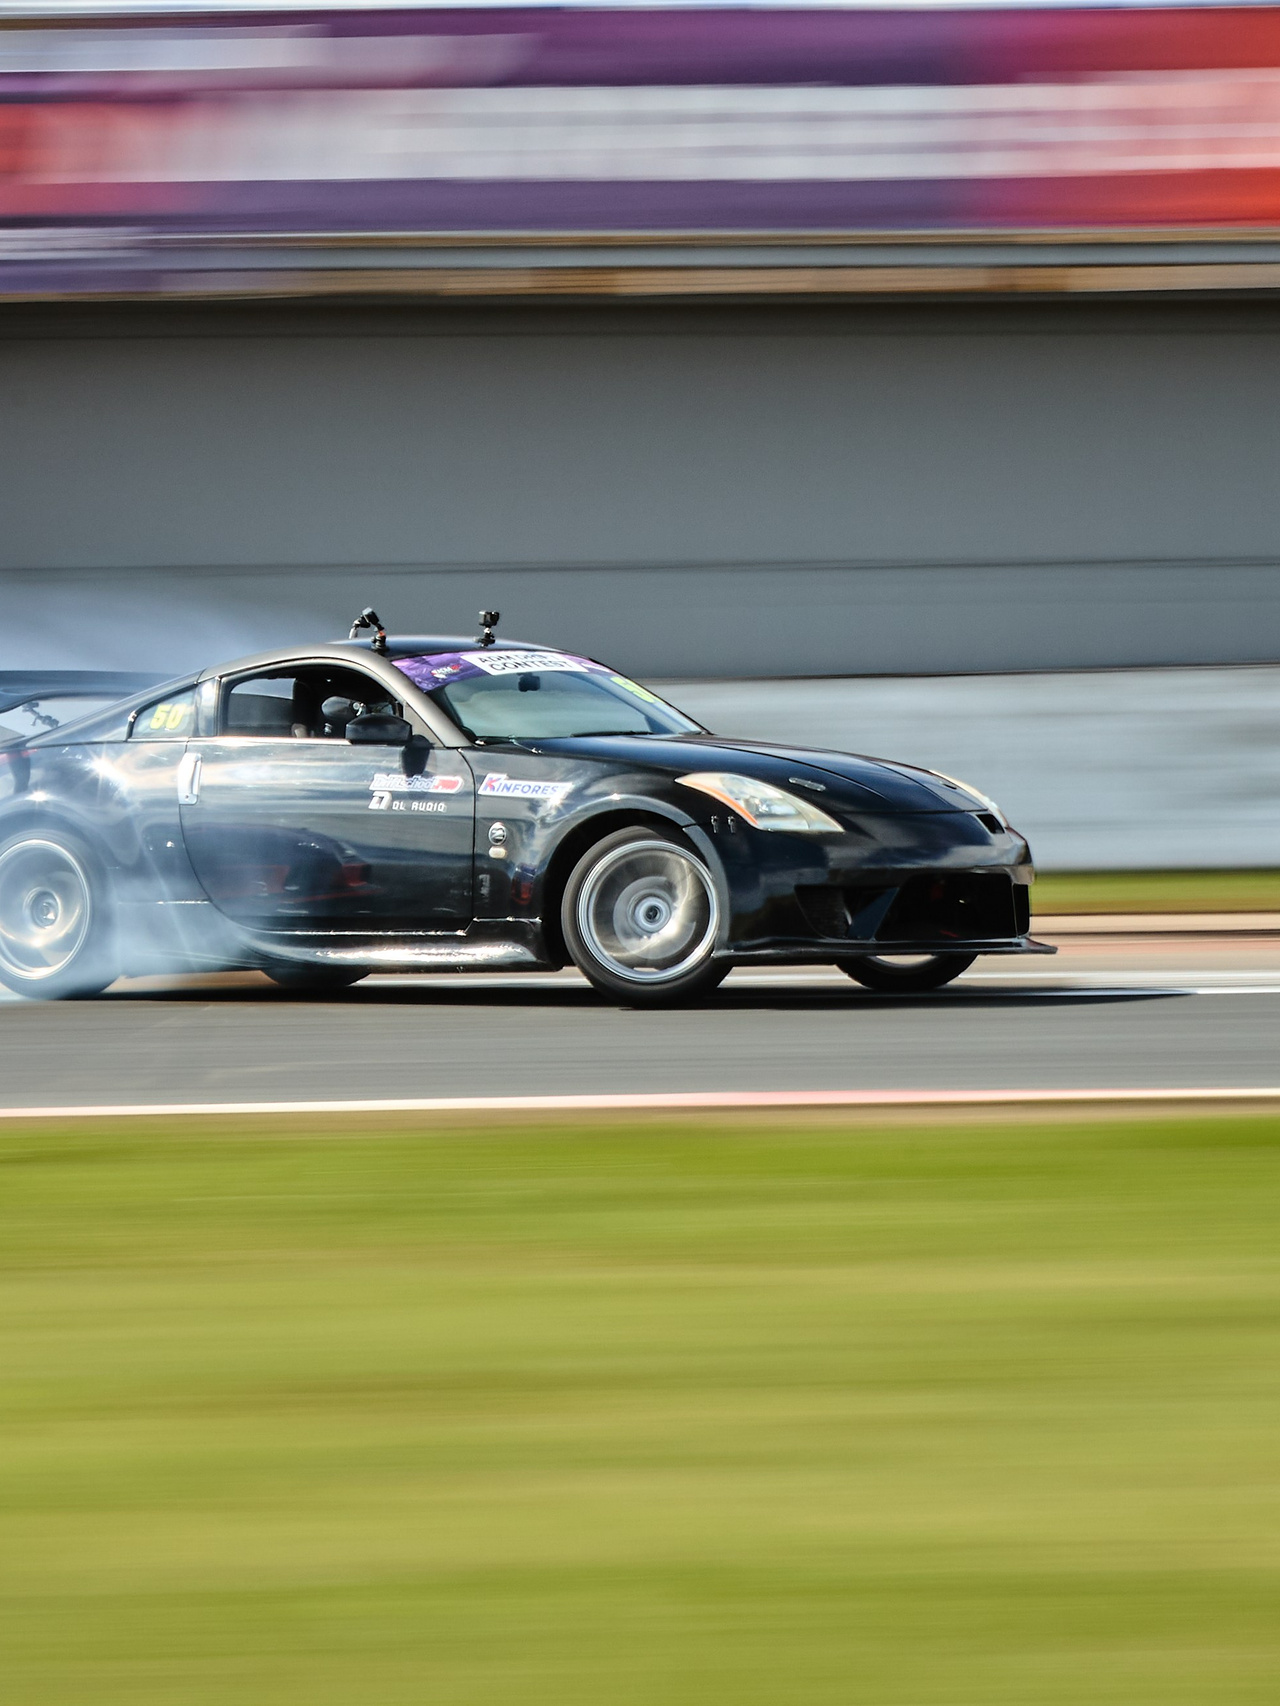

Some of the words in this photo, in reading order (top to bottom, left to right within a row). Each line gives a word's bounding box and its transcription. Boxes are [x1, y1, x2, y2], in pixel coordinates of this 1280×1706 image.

[490, 660, 573, 671] CONTEST
[150, 704, 187, 730] 50
[411, 801, 446, 812] AUDIO
